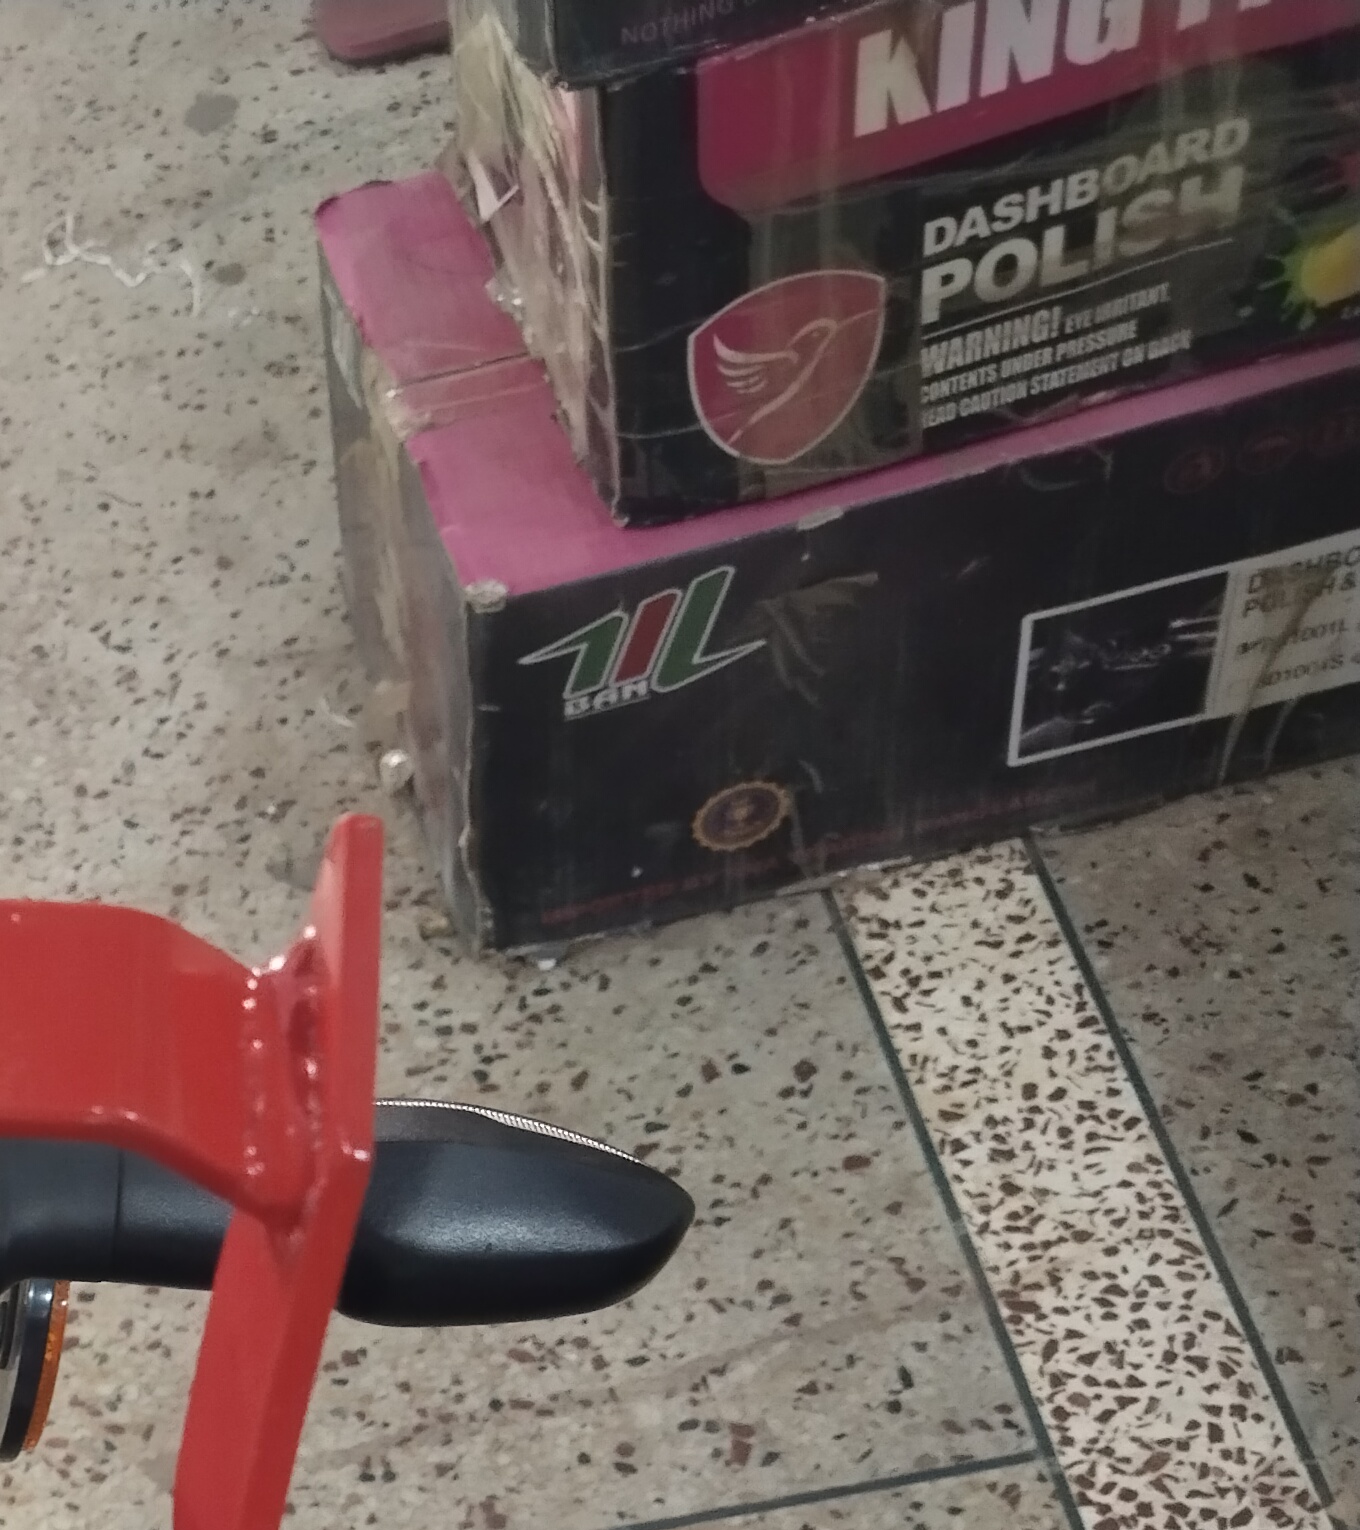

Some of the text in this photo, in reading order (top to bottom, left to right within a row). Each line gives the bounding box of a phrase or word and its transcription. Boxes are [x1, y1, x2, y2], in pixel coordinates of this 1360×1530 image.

[854, 0, 1143, 137] KING
[923, 118, 1251, 257] DASHBOARD
[921, 165, 1244, 324] POLISH
[921, 305, 1063, 379] WARNING!
[1064, 309, 1093, 335] EYE
[921, 318, 1139, 404] CONTENTS UNDER PRESSURE
[959, 380, 1028, 417] CAUTION
[1030, 352, 1120, 395] STATEMENT
